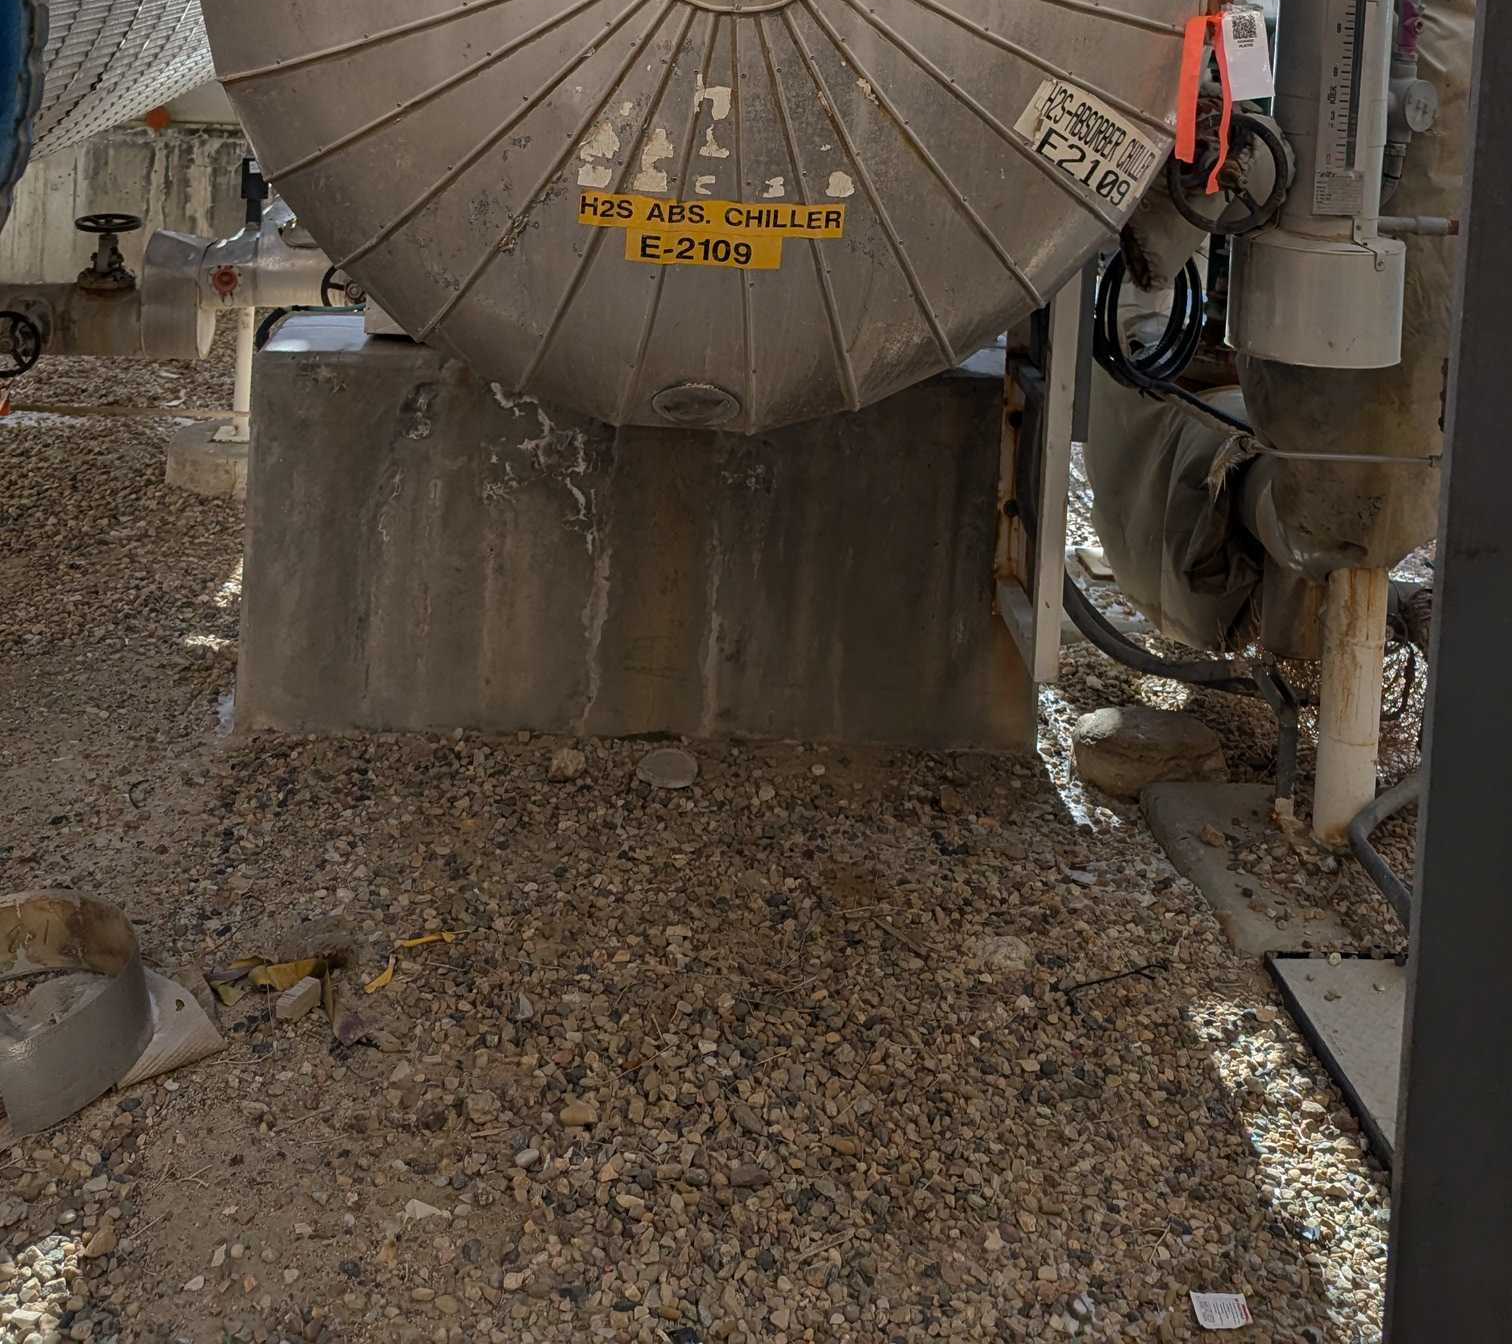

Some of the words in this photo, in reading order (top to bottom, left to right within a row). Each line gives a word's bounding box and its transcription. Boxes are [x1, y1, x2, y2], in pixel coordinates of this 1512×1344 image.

[1040, 83, 1127, 162] H2S-ABSORBER
[1035, 127, 1131, 207] E2109
[580, 195, 634, 219] H2S
[646, 205, 711, 225] ABS.
[724, 207, 842, 230] CHILLER
[639, 234, 753, 266] E-2109
